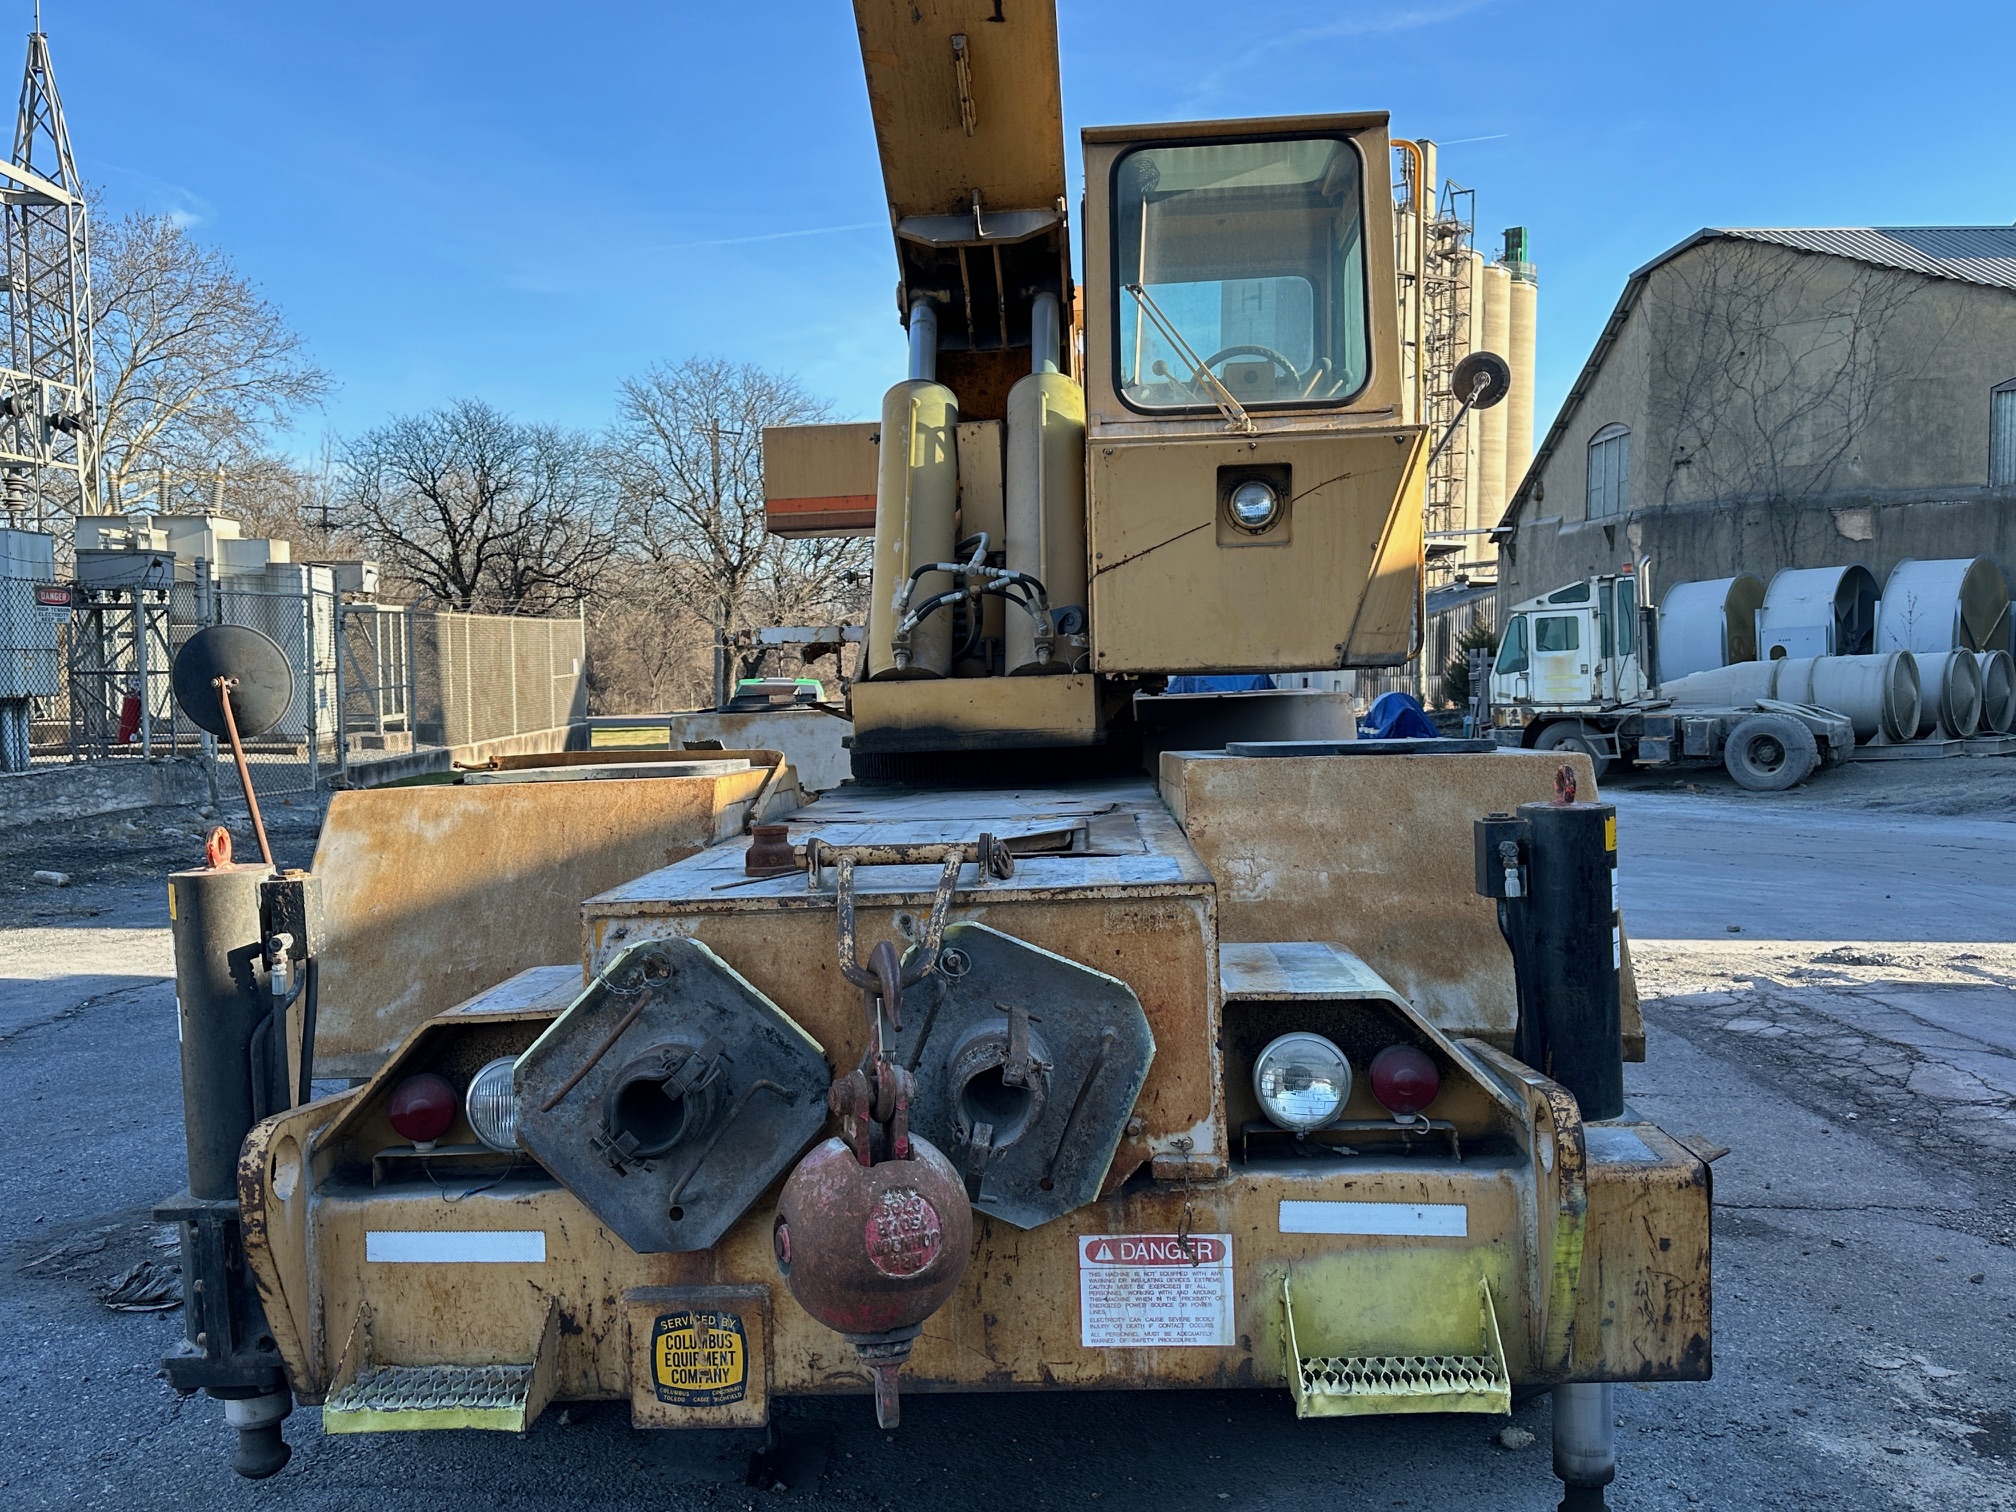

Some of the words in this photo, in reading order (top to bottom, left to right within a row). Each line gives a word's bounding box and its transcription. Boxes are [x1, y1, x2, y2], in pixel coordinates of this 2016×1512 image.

[41, 592, 67, 600] DANGER
[1121, 1242, 1213, 1260] DANGER
[721, 1317, 736, 1328] BY
[671, 1368, 730, 1384] COMANY
[660, 1387, 690, 1397] COLUMBUS
